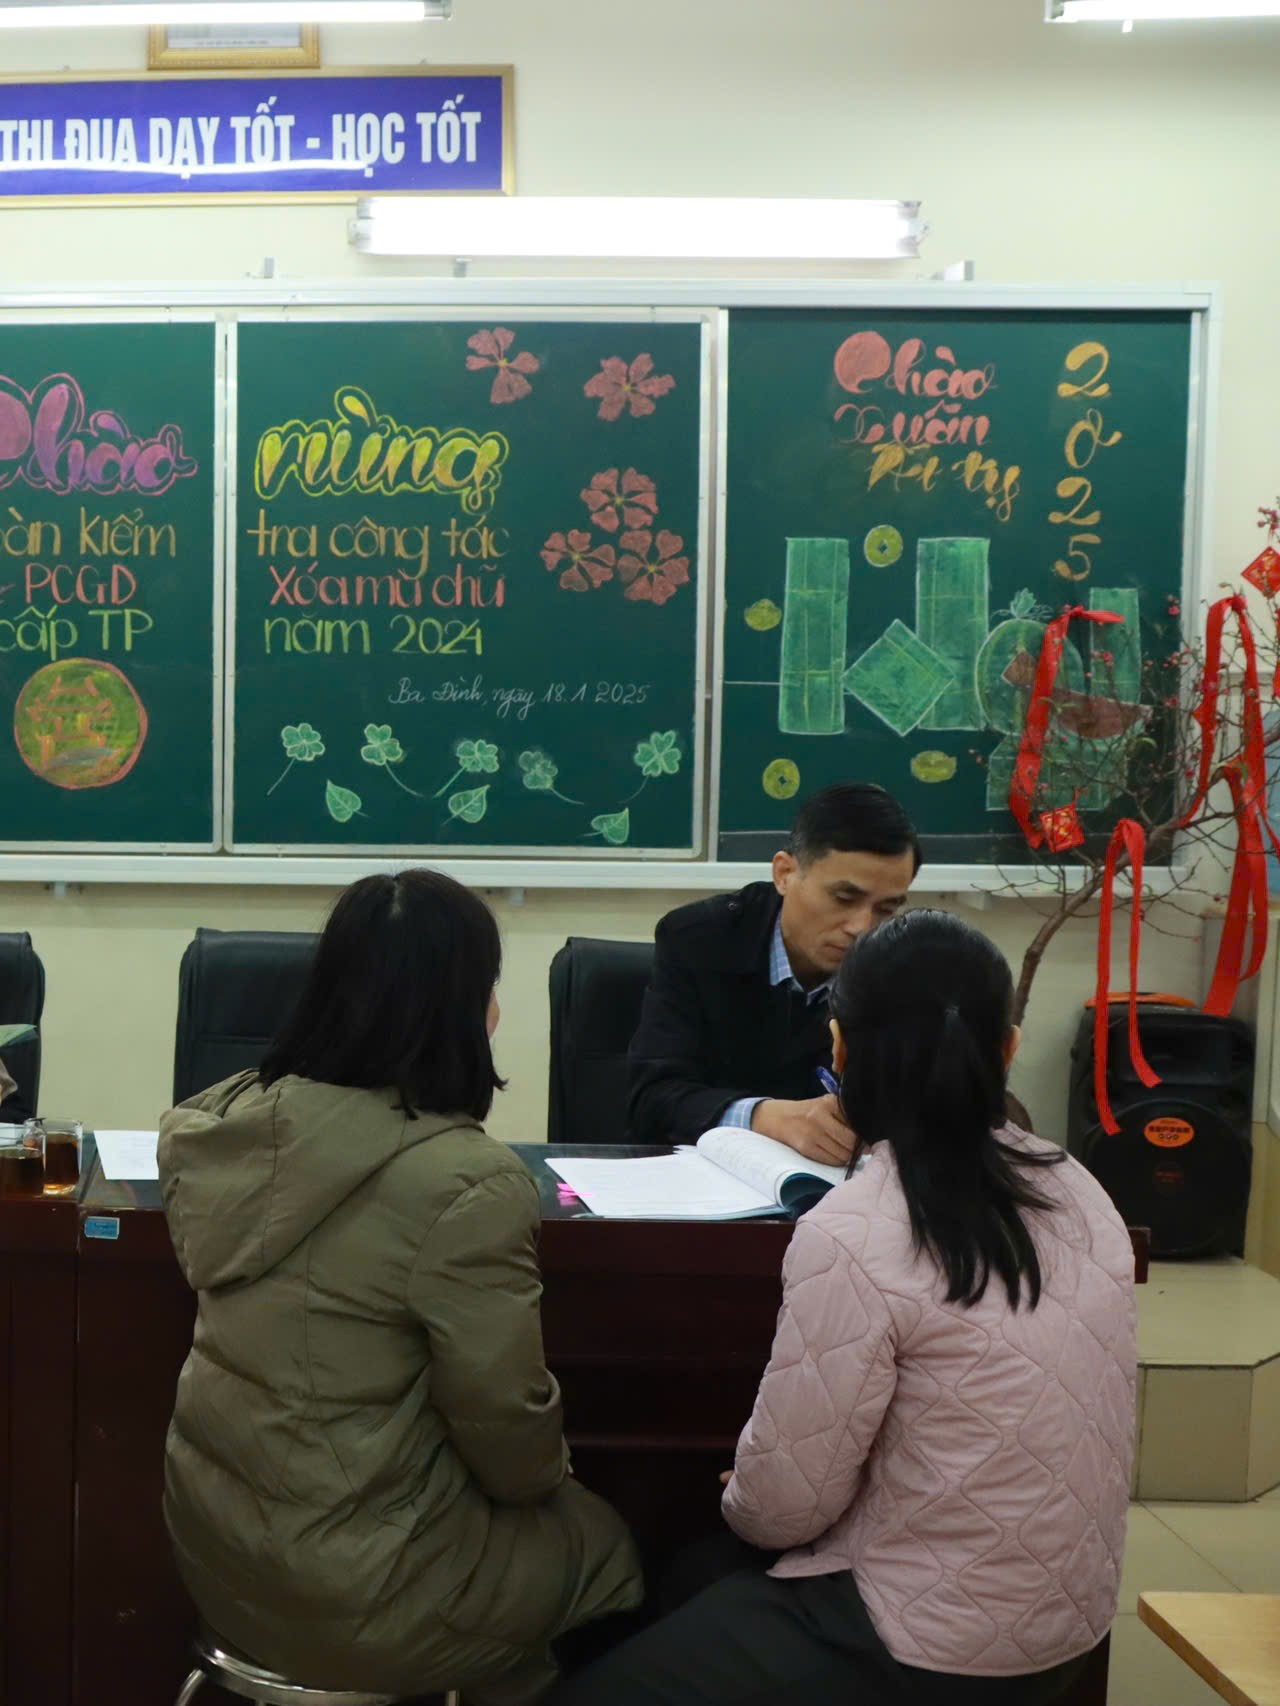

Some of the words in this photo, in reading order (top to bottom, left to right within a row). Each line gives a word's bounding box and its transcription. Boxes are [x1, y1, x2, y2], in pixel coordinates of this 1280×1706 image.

[64, 117, 131, 166] ĐUA
[149, 116, 220, 180] DẠY
[230, 94, 296, 166] TỐT
[331, 112, 405, 178] HỌC
[415, 94, 482, 164] TỐT
[833, 330, 999, 400] Chào
[254, 385, 510, 516] mừng
[833, 400, 992, 446] Xuân
[80, 506, 177, 558] kiểm
[246, 507, 318, 559] tra
[329, 516, 430, 578] công
[441, 515, 511, 560] tác
[25, 562, 138, 605] PCGD
[87, 608, 154, 652] TP
[264, 611, 371, 655] năm
[389, 613, 484, 656] 2024
[388, 676, 426, 705] Ba
